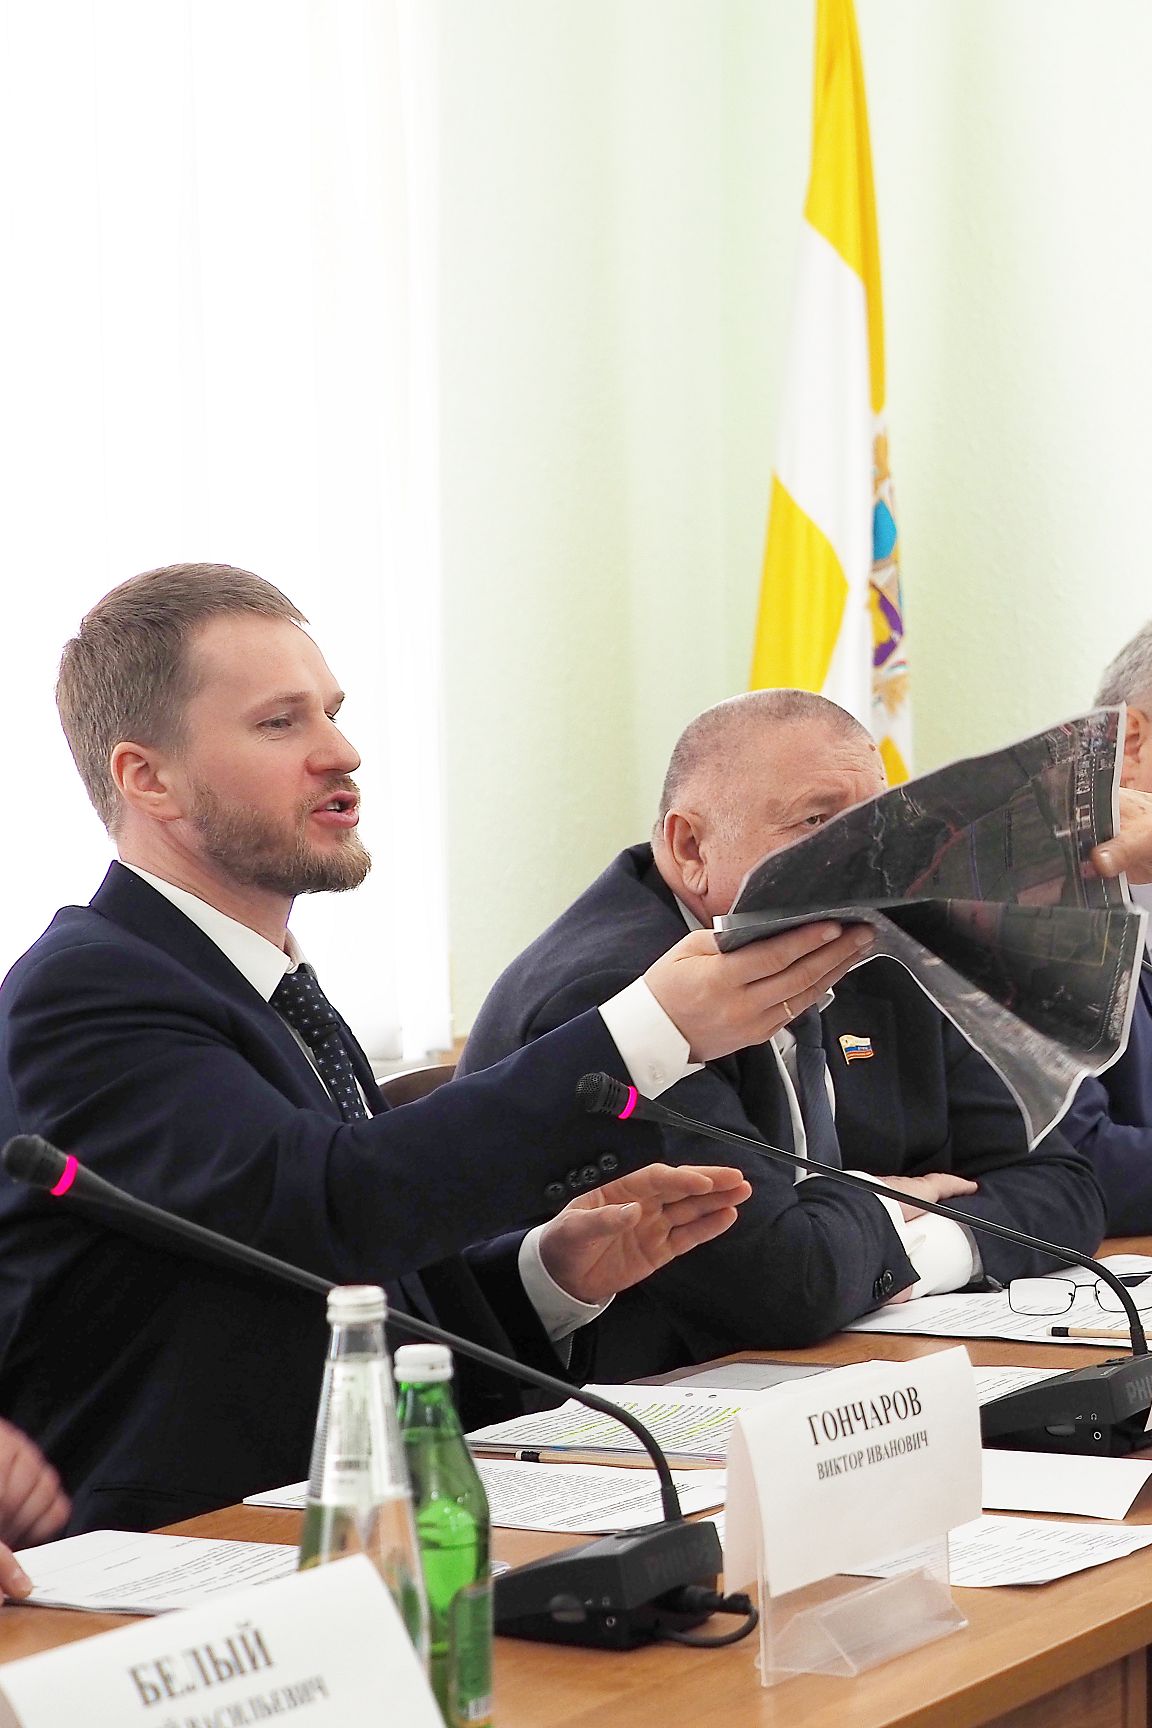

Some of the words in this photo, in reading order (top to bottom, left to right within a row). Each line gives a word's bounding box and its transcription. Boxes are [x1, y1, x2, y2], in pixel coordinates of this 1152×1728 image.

[806, 1386, 923, 1445] ГОНЧАРОВ
[816, 1452, 863, 1481] ВИКТОР
[866, 1430, 929, 1465] ИВАНОВИЧ
[129, 1620, 275, 1707] БЕЛЫЙ
